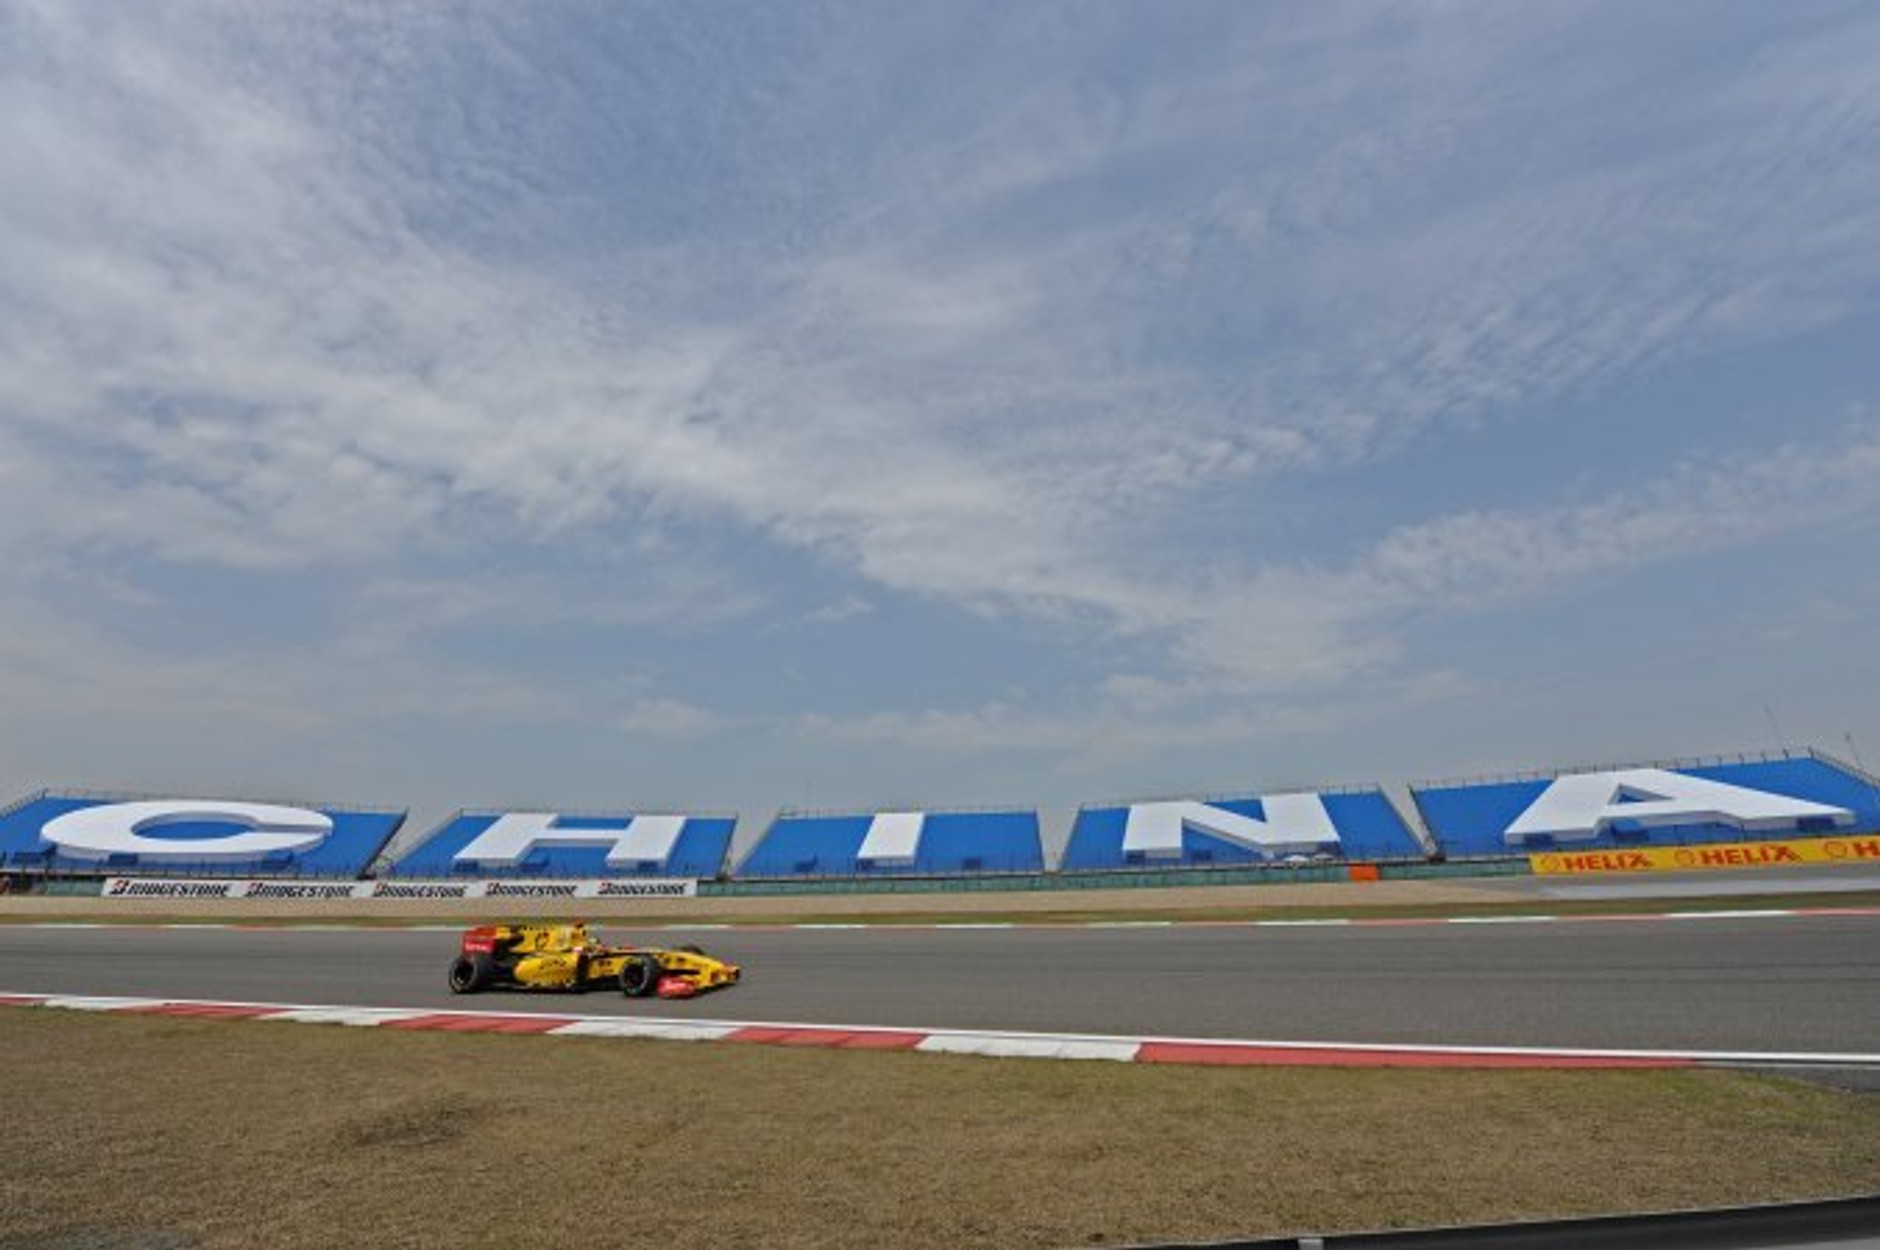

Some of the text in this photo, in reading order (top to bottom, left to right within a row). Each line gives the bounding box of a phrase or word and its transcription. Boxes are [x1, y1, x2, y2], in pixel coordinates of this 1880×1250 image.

[40, 767, 1855, 863] CHINA
[1562, 851, 1654, 870] HELIX
[1701, 844, 1802, 864] HELIX
[109, 879, 229, 896] BRIDGESTONE
